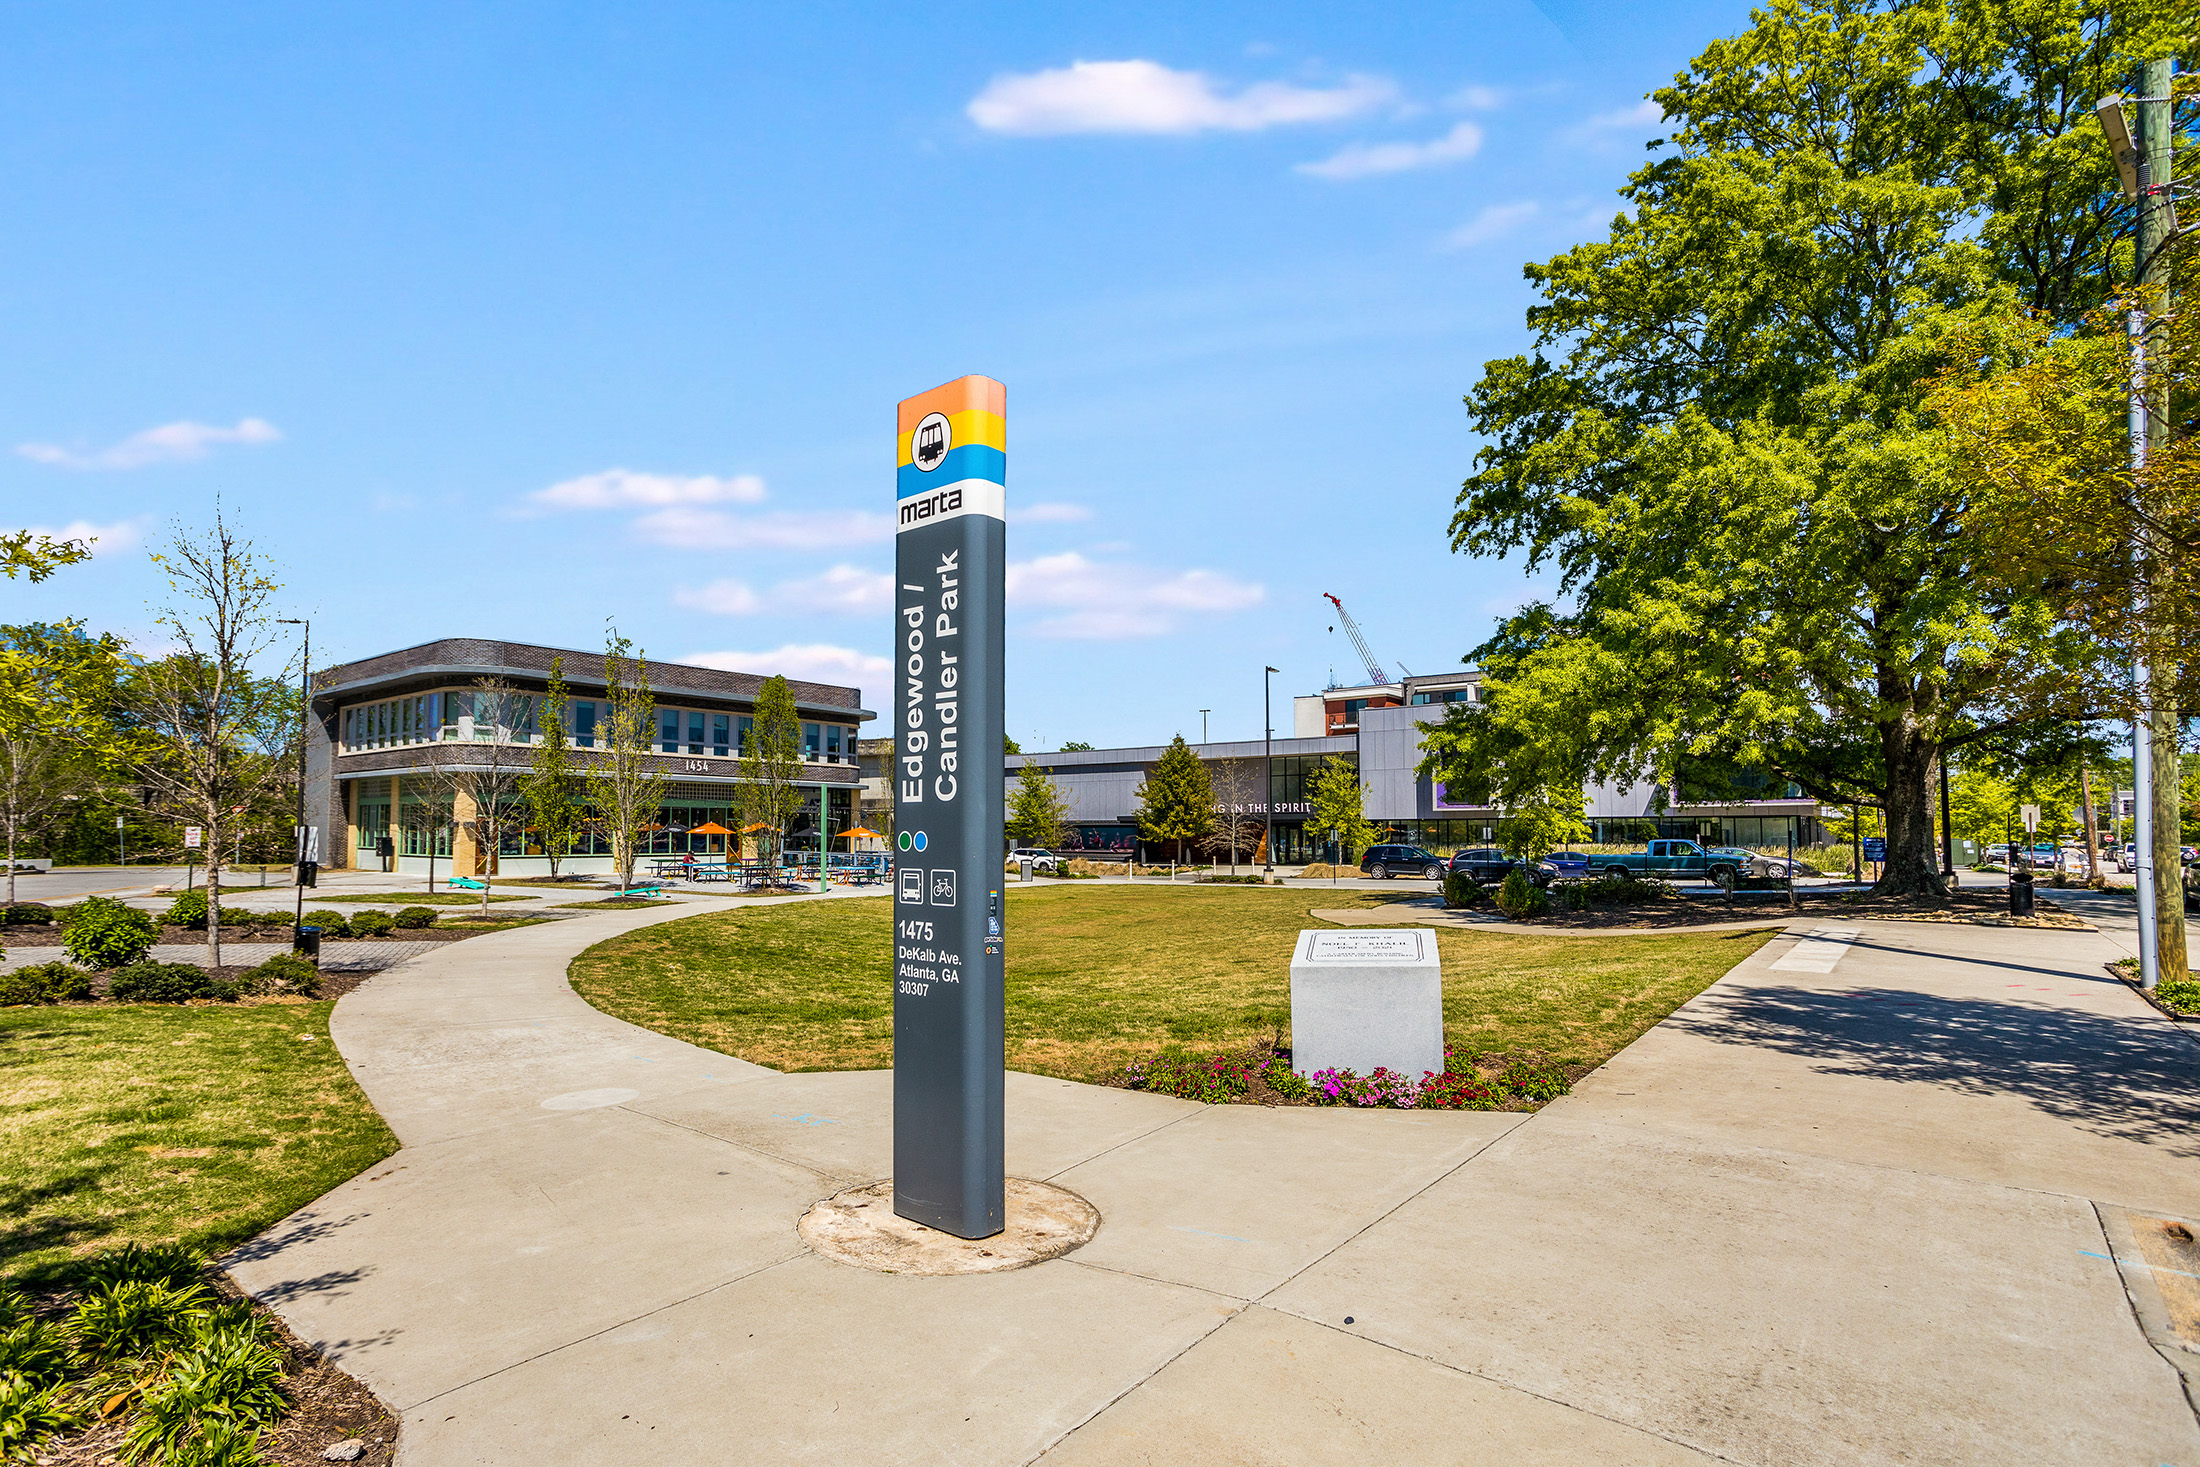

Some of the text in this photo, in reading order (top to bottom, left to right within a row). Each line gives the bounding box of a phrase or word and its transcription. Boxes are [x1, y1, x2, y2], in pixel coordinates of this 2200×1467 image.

[900, 488, 962, 525] marta
[934, 548, 959, 802] Candler Park
[902, 583, 928, 803] Edgewood /
[685, 760, 709, 772] 1454
[1248, 803, 1268, 813] THE
[1274, 802, 1311, 814] SPIRIT
[899, 919, 934, 941] 1475
[899, 945, 962, 966] DeKalb Ave.
[899, 963, 960, 984] Atlanta, GA
[899, 980, 929, 997] 30307
